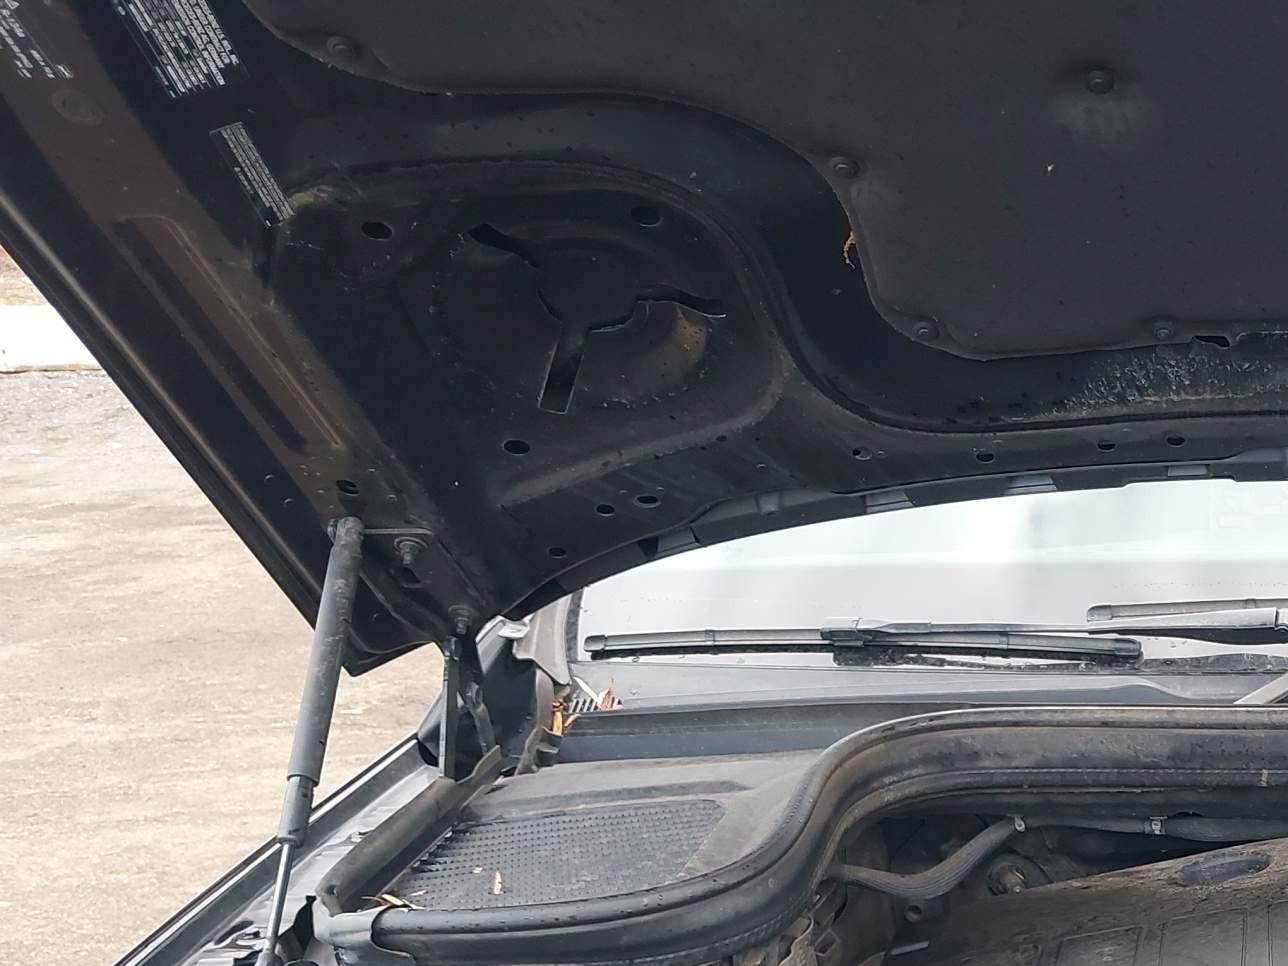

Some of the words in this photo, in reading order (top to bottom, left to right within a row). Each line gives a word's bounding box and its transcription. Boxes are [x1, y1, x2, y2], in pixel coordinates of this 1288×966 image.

[186, 25, 205, 49] CONTROL
[200, 50, 226, 85] INFORMATION
[203, 25, 224, 52] CONTRACT
